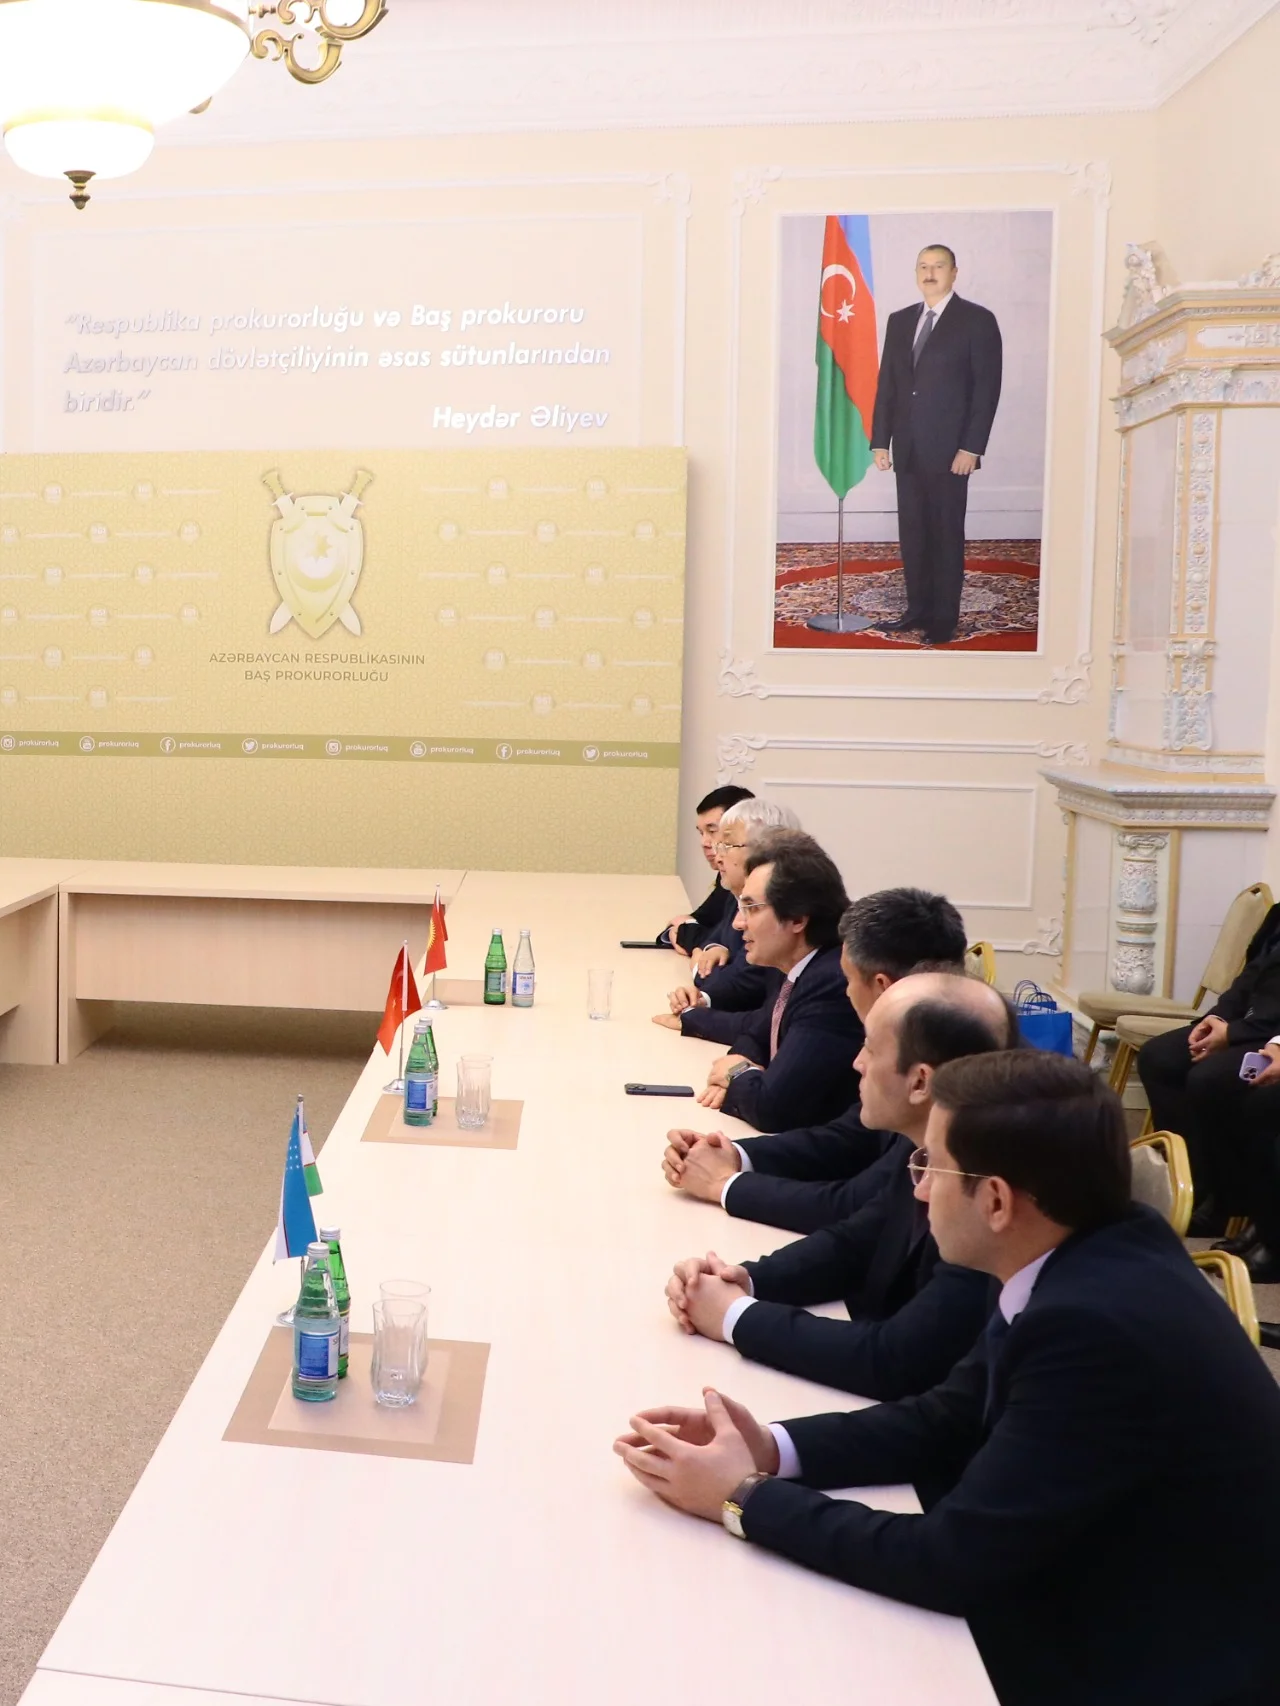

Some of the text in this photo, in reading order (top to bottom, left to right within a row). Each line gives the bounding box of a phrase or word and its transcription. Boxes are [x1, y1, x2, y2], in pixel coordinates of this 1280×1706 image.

[209, 304, 364, 336] prokurorluğu
[373, 309, 402, 327] və
[410, 304, 452, 331] Baş
[460, 301, 585, 332] prokuroru
[64, 342, 610, 376] Azərbaycan dövlətçiliyinin əsas sütunlarından
[432, 404, 609, 433] Heydər Əliyev
[209, 652, 425, 665] AZƏRBAYCAN RESPUBLİKASININ
[244, 669, 389, 682] BAŞ PROKURORLUĞU
